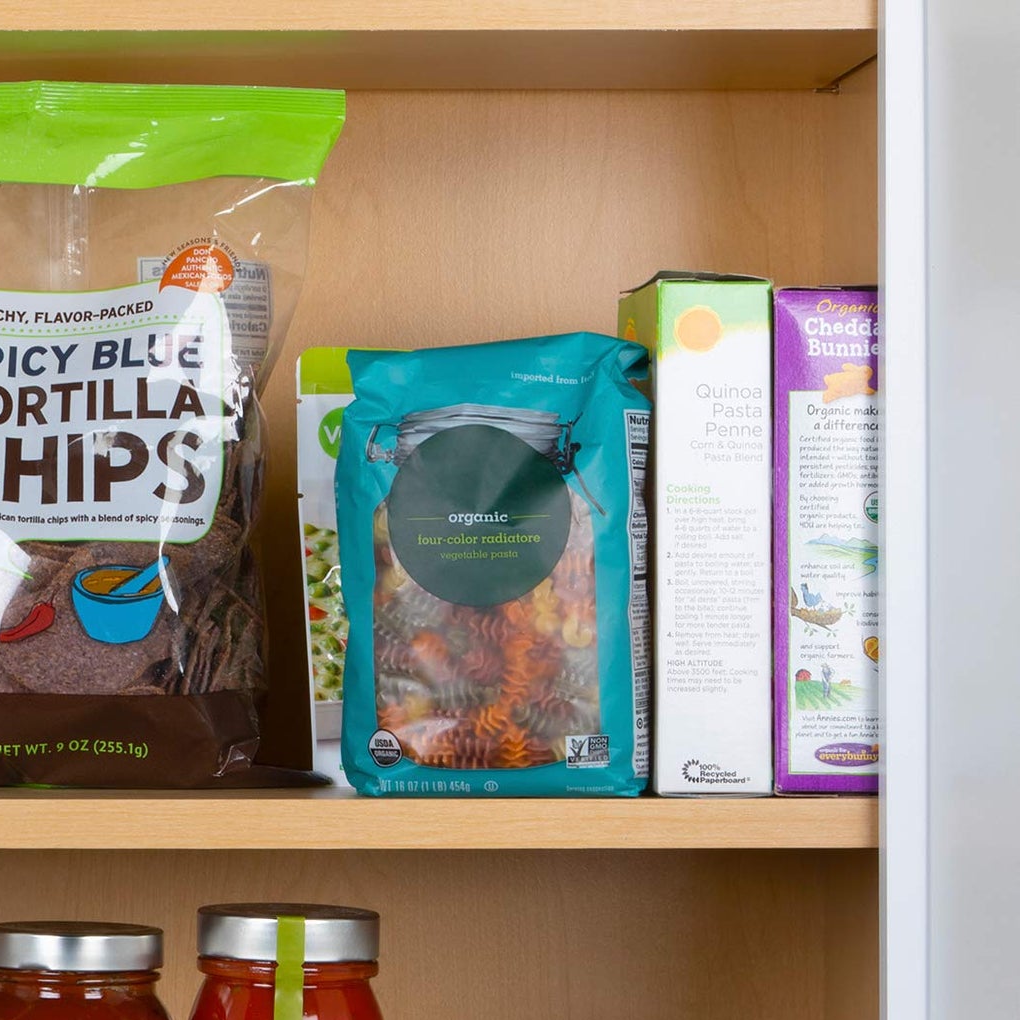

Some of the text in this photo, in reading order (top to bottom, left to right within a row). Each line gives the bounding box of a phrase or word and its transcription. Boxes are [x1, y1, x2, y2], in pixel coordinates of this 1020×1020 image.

[162, 251, 176, 266] NEW
[193, 248, 212, 256] DON
[33, 300, 154, 325] FLAVOR-PACKED
[816, 299, 878, 317] Organic
[91, 333, 206, 371] BLUE
[511, 370, 554, 384] imported
[555, 374, 579, 385] from
[696, 383, 763, 400] Quinoa
[712, 403, 763, 418] Pasta
[807, 404, 851, 420] Organic
[705, 422, 763, 437] Penne
[814, 422, 821, 431] a
[690, 440, 764, 451] Corn & Quinoa
[704, 453, 764, 463] Pasta Blend
[666, 483, 711, 495] Cooking
[666, 495, 722, 505] Directions
[17, 515, 46, 524] tortilla
[47, 515, 69, 525] chips
[70, 514, 90, 523] with
[98, 513, 122, 523] blend
[124, 513, 135, 523] of
[135, 513, 159, 525] spicy
[448, 510, 509, 527] organic
[417, 532, 541, 545] four-color radiatore
[439, 550, 519, 561] vegetable pasta
[25, 743, 52, 755] WT.
[56, 742, 64, 753] 9
[68, 739, 89, 752] OZ
[93, 739, 149, 759] (255.1g)
[375, 739, 394, 748] USDA
[699, 763, 721, 771] 100%
[699, 770, 737, 778] Recycled
[394, 779, 405, 792] 16
[407, 780, 418, 792] OZ
[432, 779, 448, 793] LB)
[449, 779, 471, 793] 454g
[699, 777, 746, 785] Paperboard
